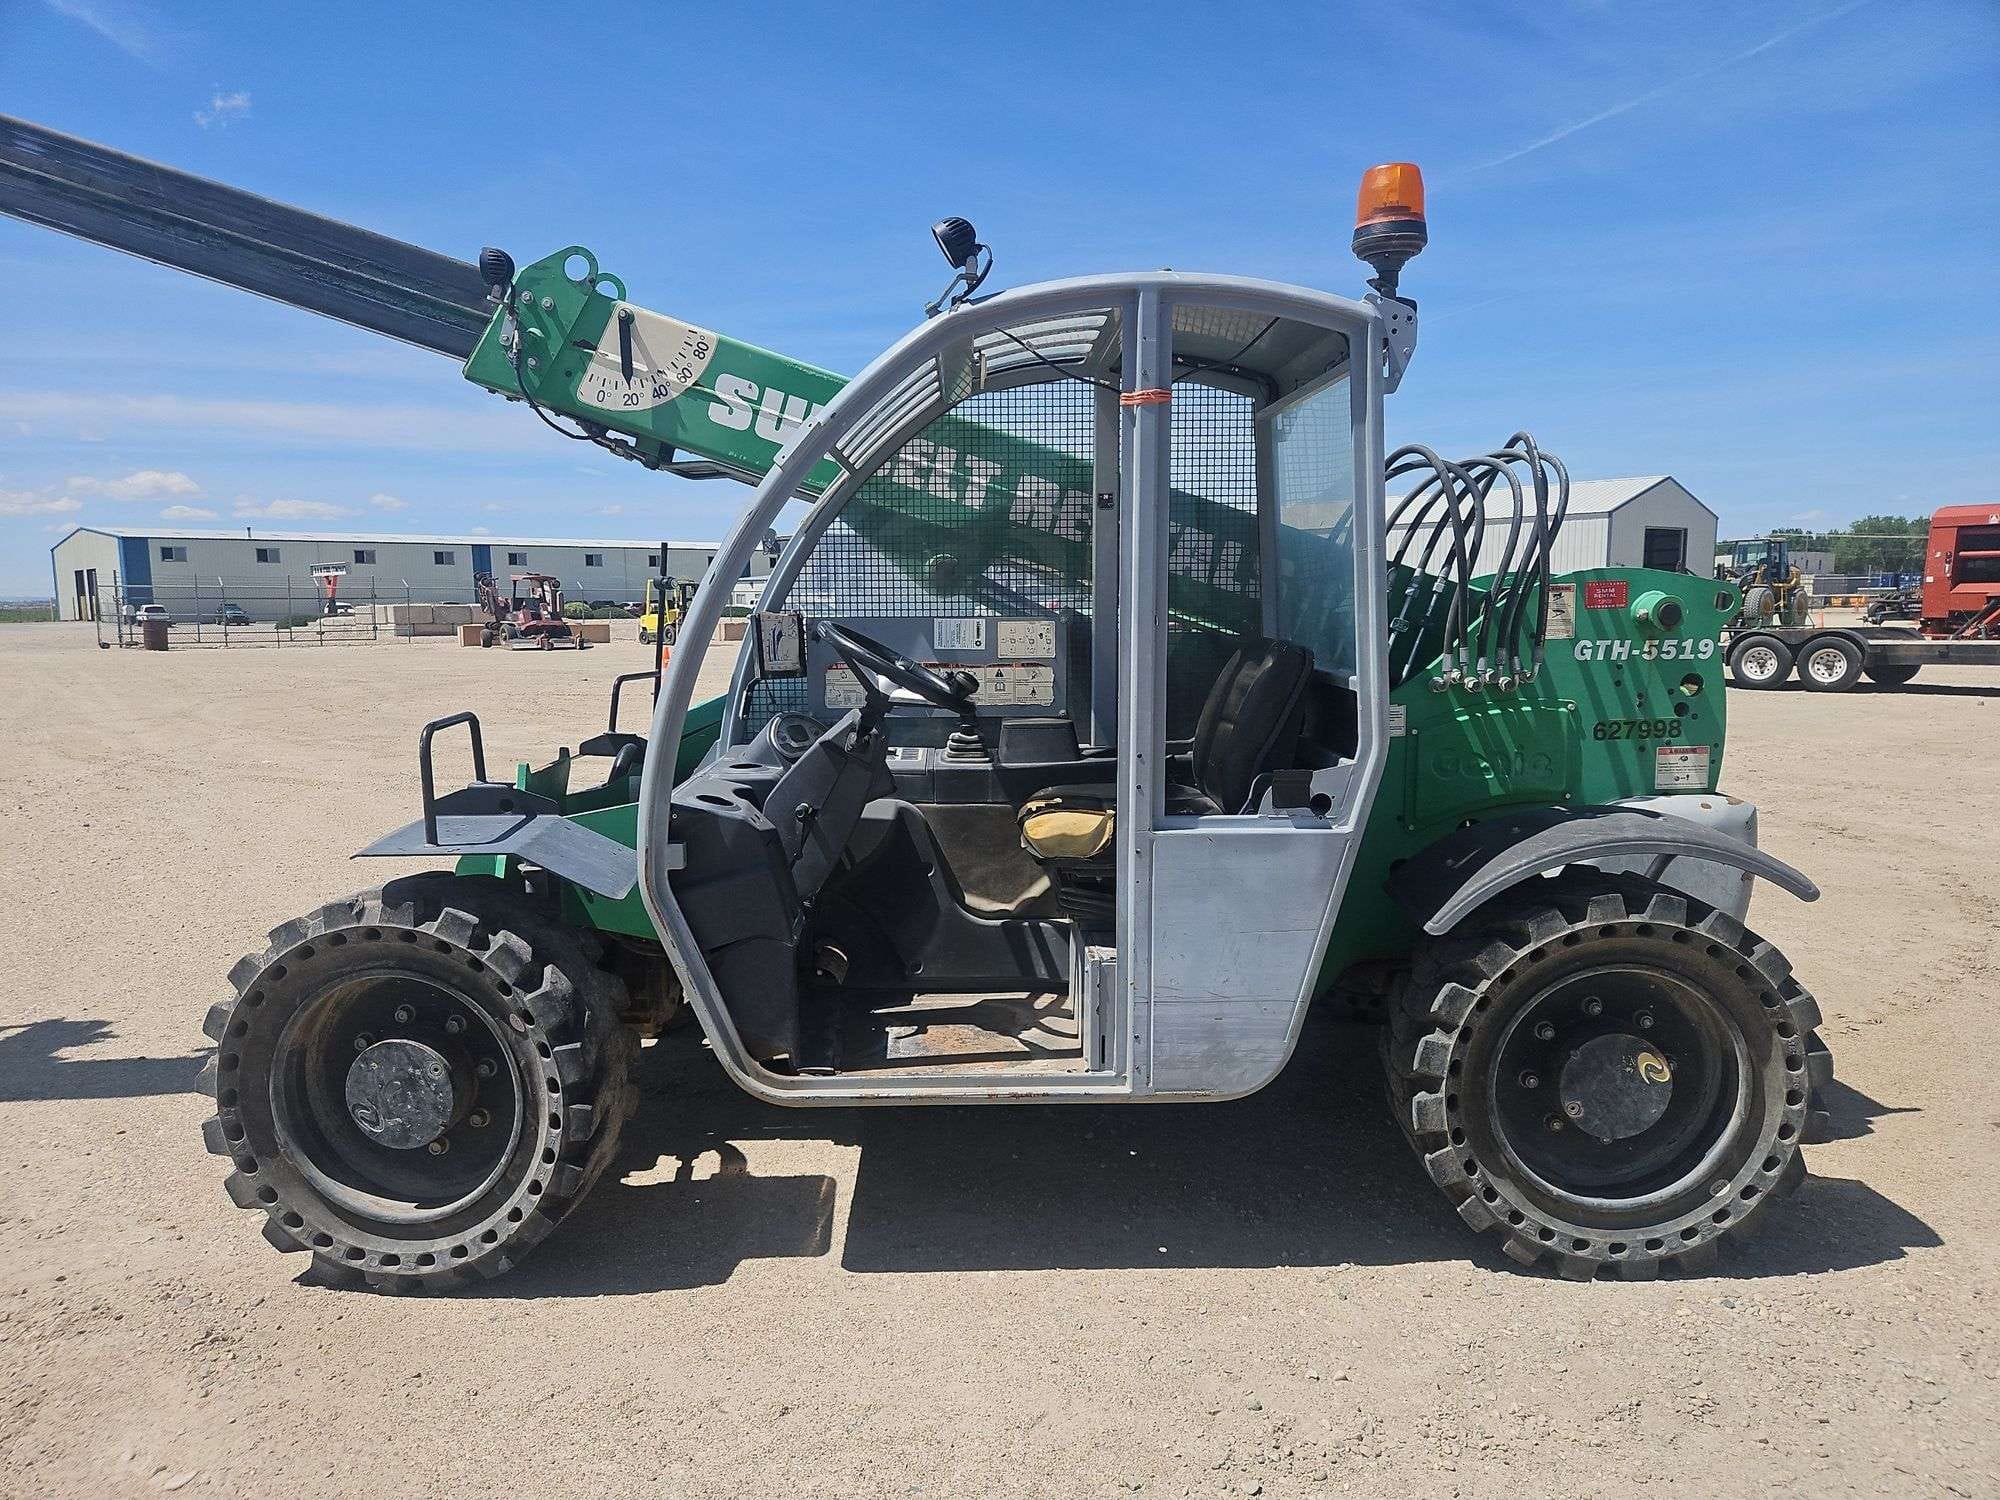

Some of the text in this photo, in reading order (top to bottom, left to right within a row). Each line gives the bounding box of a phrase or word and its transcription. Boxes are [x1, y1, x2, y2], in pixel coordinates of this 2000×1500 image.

[708, 373, 1004, 511] SUELT
[1574, 638, 1715, 661] GTH-5519
[1593, 719, 1682, 741] 627998
